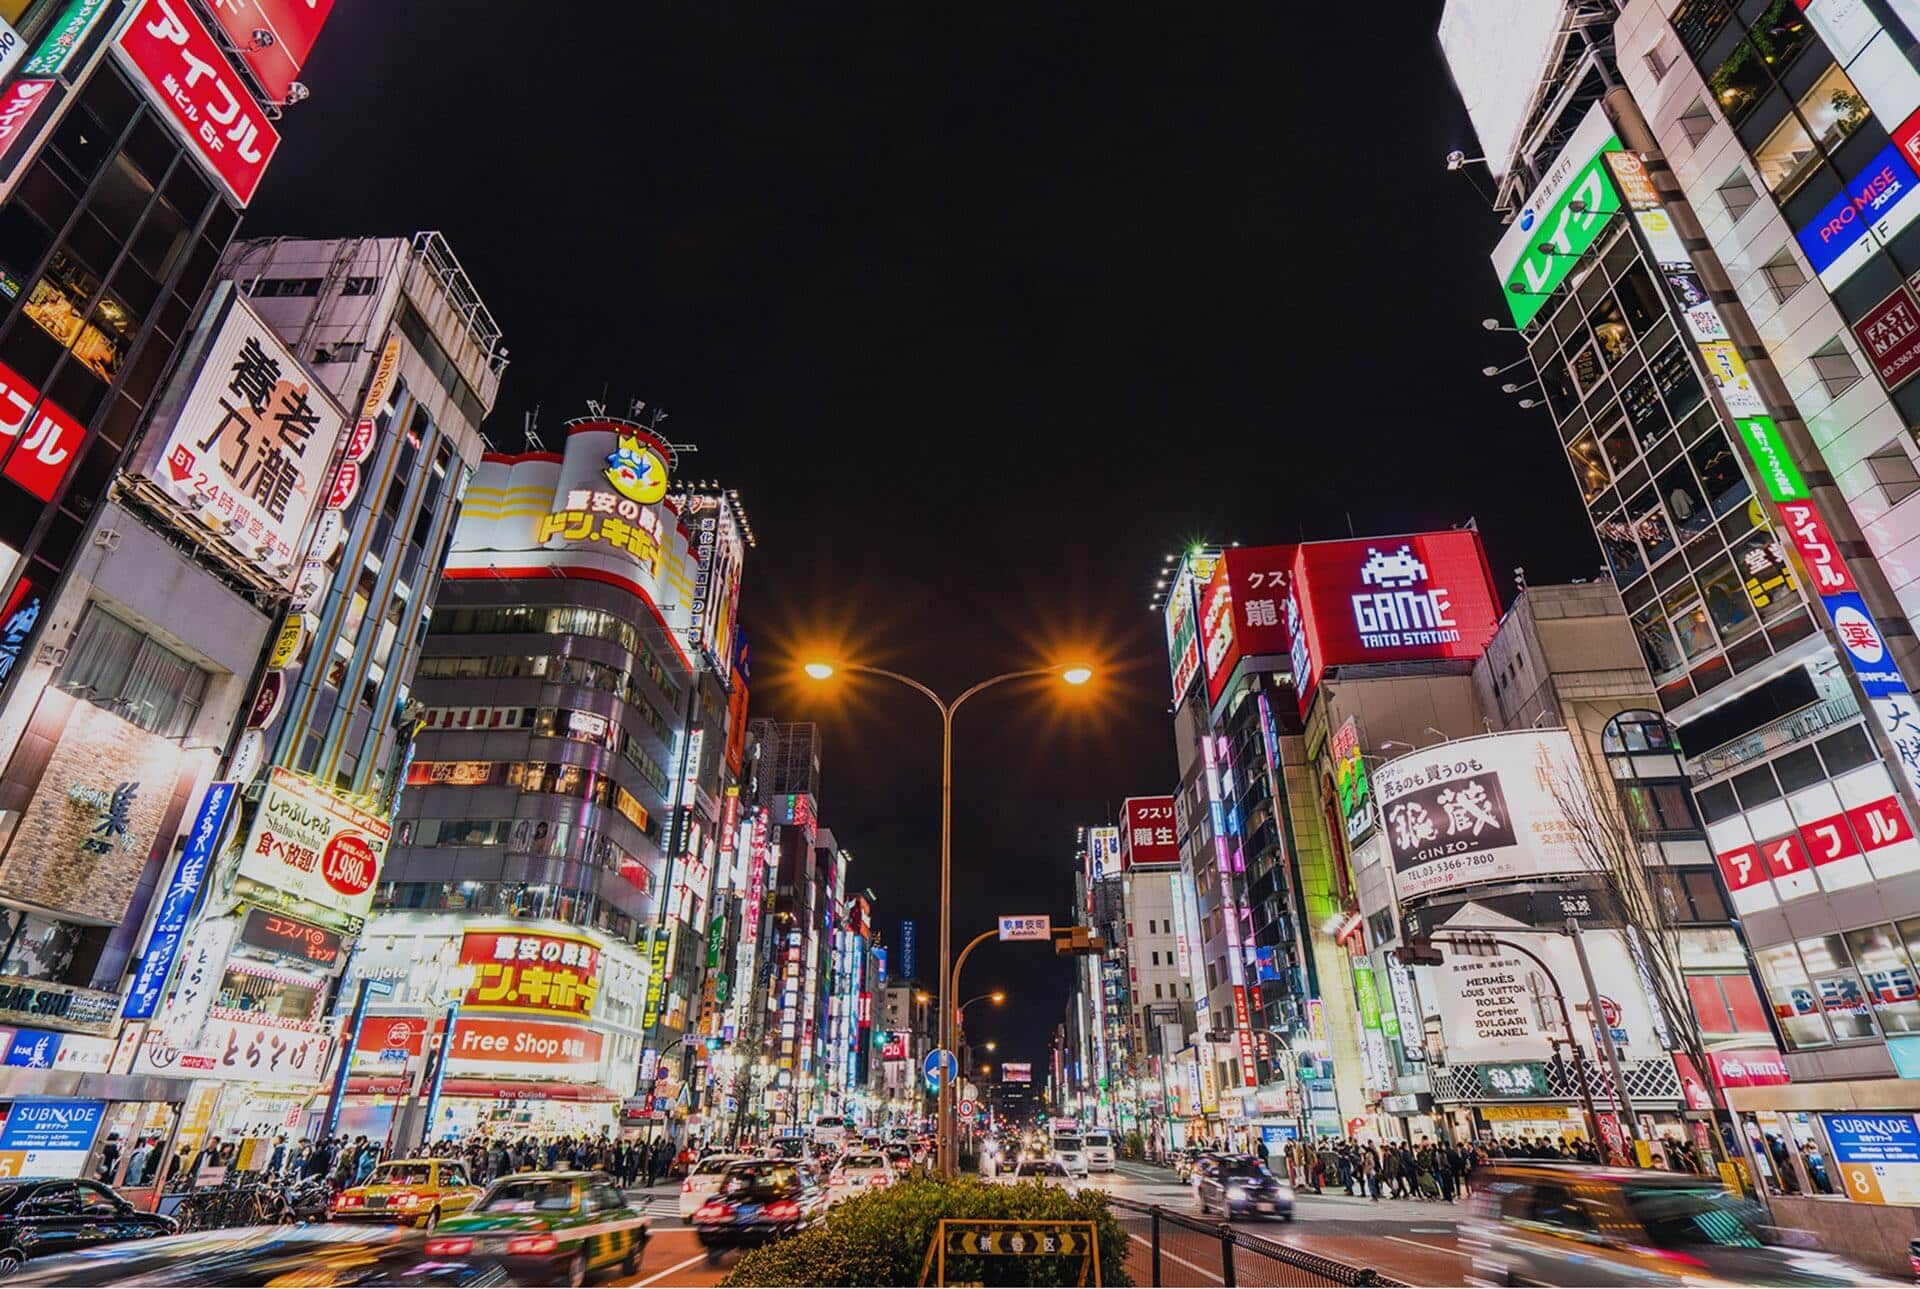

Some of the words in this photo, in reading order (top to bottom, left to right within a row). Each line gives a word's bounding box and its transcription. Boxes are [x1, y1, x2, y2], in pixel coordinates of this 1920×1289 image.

[145, 0, 262, 164] アイフル
[1819, 166, 1897, 244] PROMISE
[1867, 304, 1906, 341] FAST
[1874, 318, 1916, 354] NAIL
[226, 335, 321, 459] 養老
[197, 394, 303, 526] 乃瀧
[192, 470, 291, 561] 24時間営業中
[1785, 505, 1844, 587] アイフル
[1351, 588, 1456, 633] GAME
[1360, 632, 1401, 649] TAITO
[1402, 628, 1461, 647] STATION
[1839, 622, 1878, 649] 薬
[268, 791, 332, 836] しゃぶしゃぶ
[1136, 806, 1174, 820] クスリ
[1389, 779, 1501, 850] 銀蔵
[1133, 826, 1175, 847] 龍生
[1729, 808, 1898, 885] アイフル
[1460, 989, 1485, 999] LOUIS
[1487, 984, 1527, 996] VUITTON
[1475, 996, 1517, 1008] ROLEX
[1475, 1016, 1528, 1028] BVLGARI
[1476, 1006, 1520, 1018] Cartier
[461, 1030, 510, 1051] Free
[513, 1031, 559, 1058] Shop
[1477, 1027, 1529, 1039] CHANEL
[499, 1090, 518, 1099] Don
[517, 1090, 547, 1101] Quijote
[17, 1106, 97, 1124] SUBNADE
[1832, 1118, 1913, 1137] SUBNADE
[1852, 1169, 1870, 1195] 8
